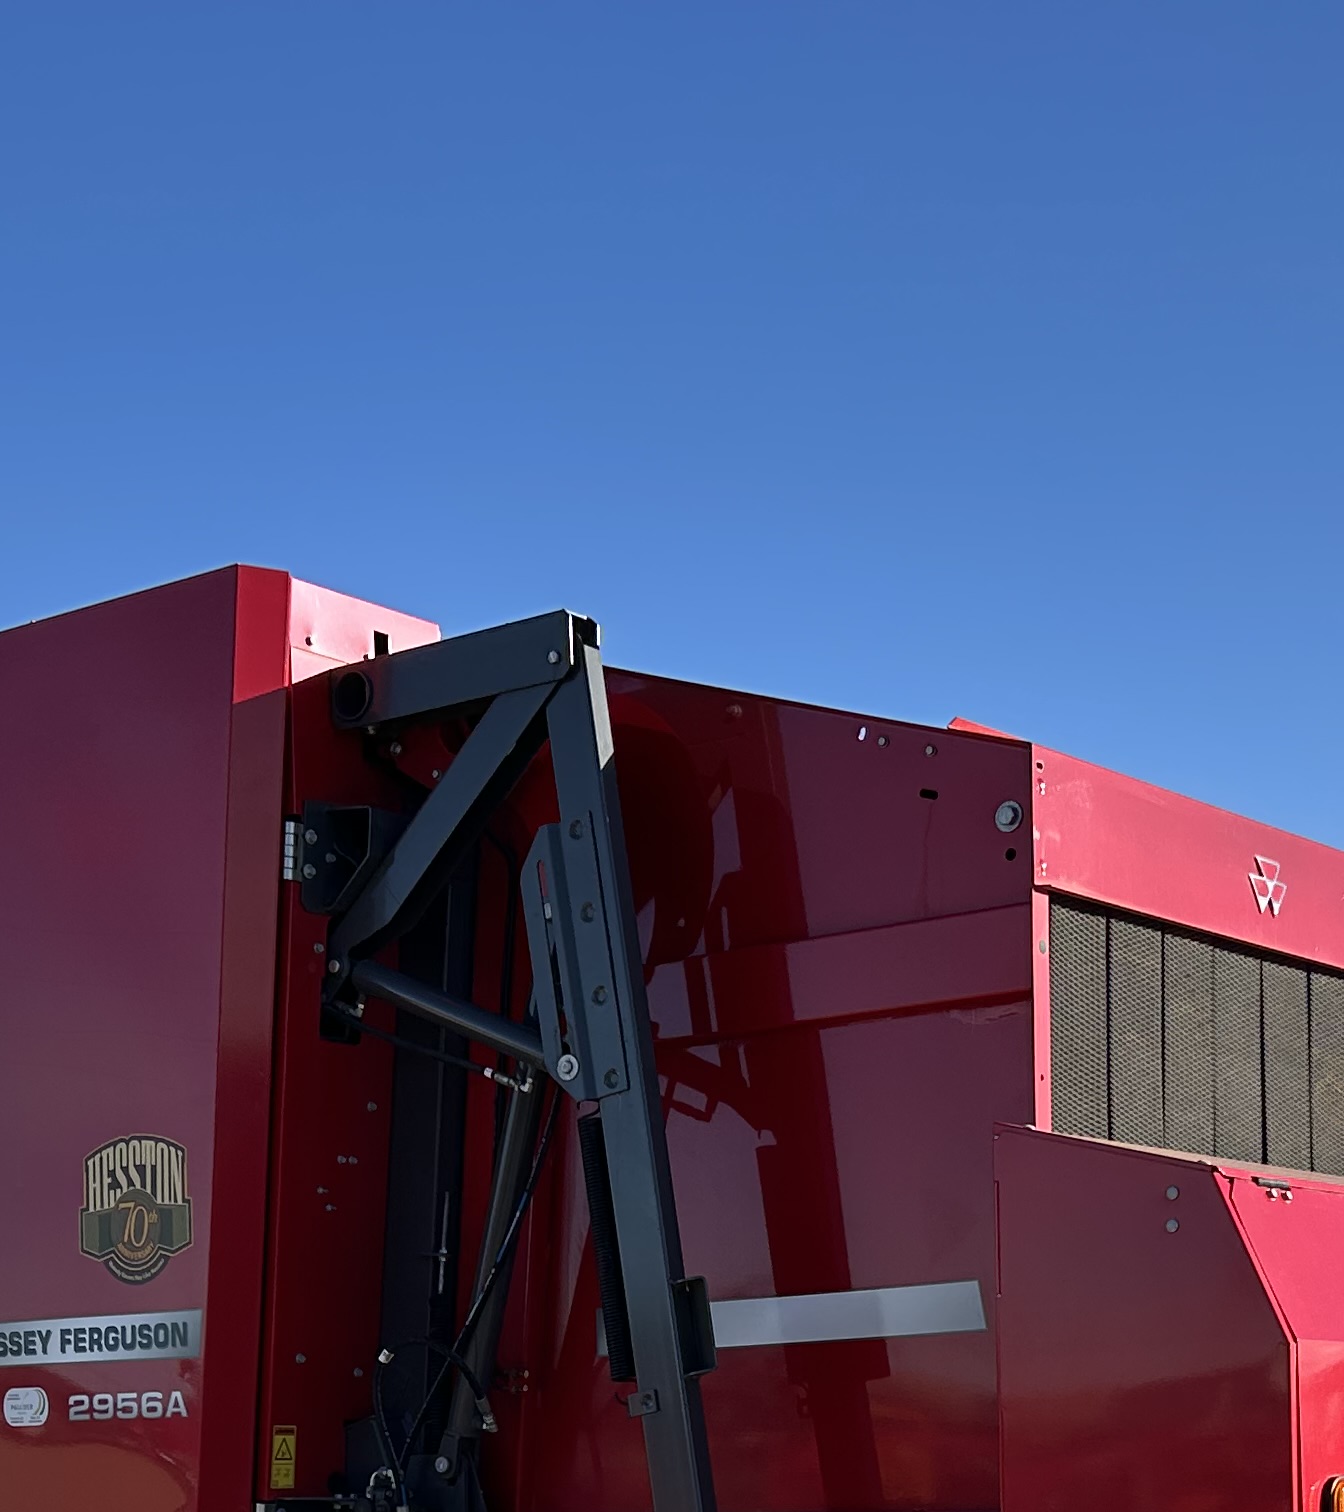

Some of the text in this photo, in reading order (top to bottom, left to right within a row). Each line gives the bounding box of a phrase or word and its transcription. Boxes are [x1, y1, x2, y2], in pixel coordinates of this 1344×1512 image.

[87, 1139, 183, 1213] HESSTON
[60, 1321, 189, 1354] FERGUSON
[68, 1391, 189, 1421] 2956A
